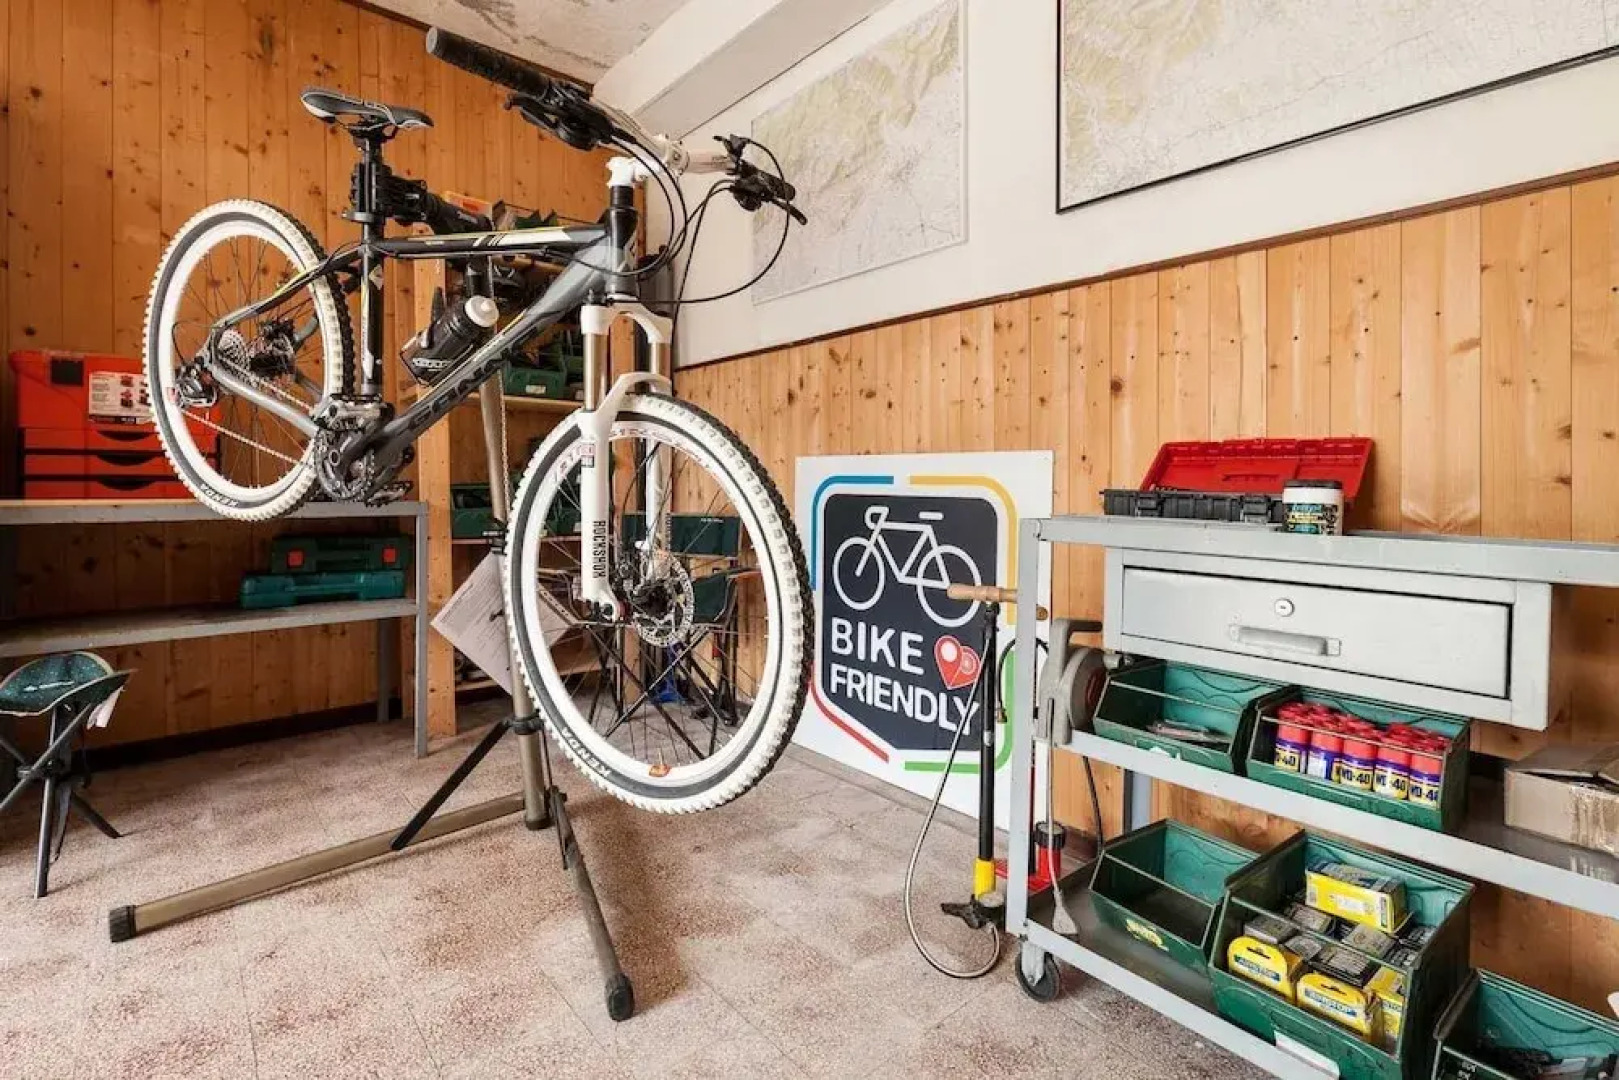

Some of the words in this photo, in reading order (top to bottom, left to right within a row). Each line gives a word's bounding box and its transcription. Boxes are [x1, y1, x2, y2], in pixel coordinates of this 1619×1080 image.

[592, 520, 607, 579] ROCKSHOX
[831, 617, 924, 676] BIKE
[830, 664, 980, 736] FRIENDLY
[562, 727, 611, 777] KENDA
[1340, 768, 1371, 785] WD-40
